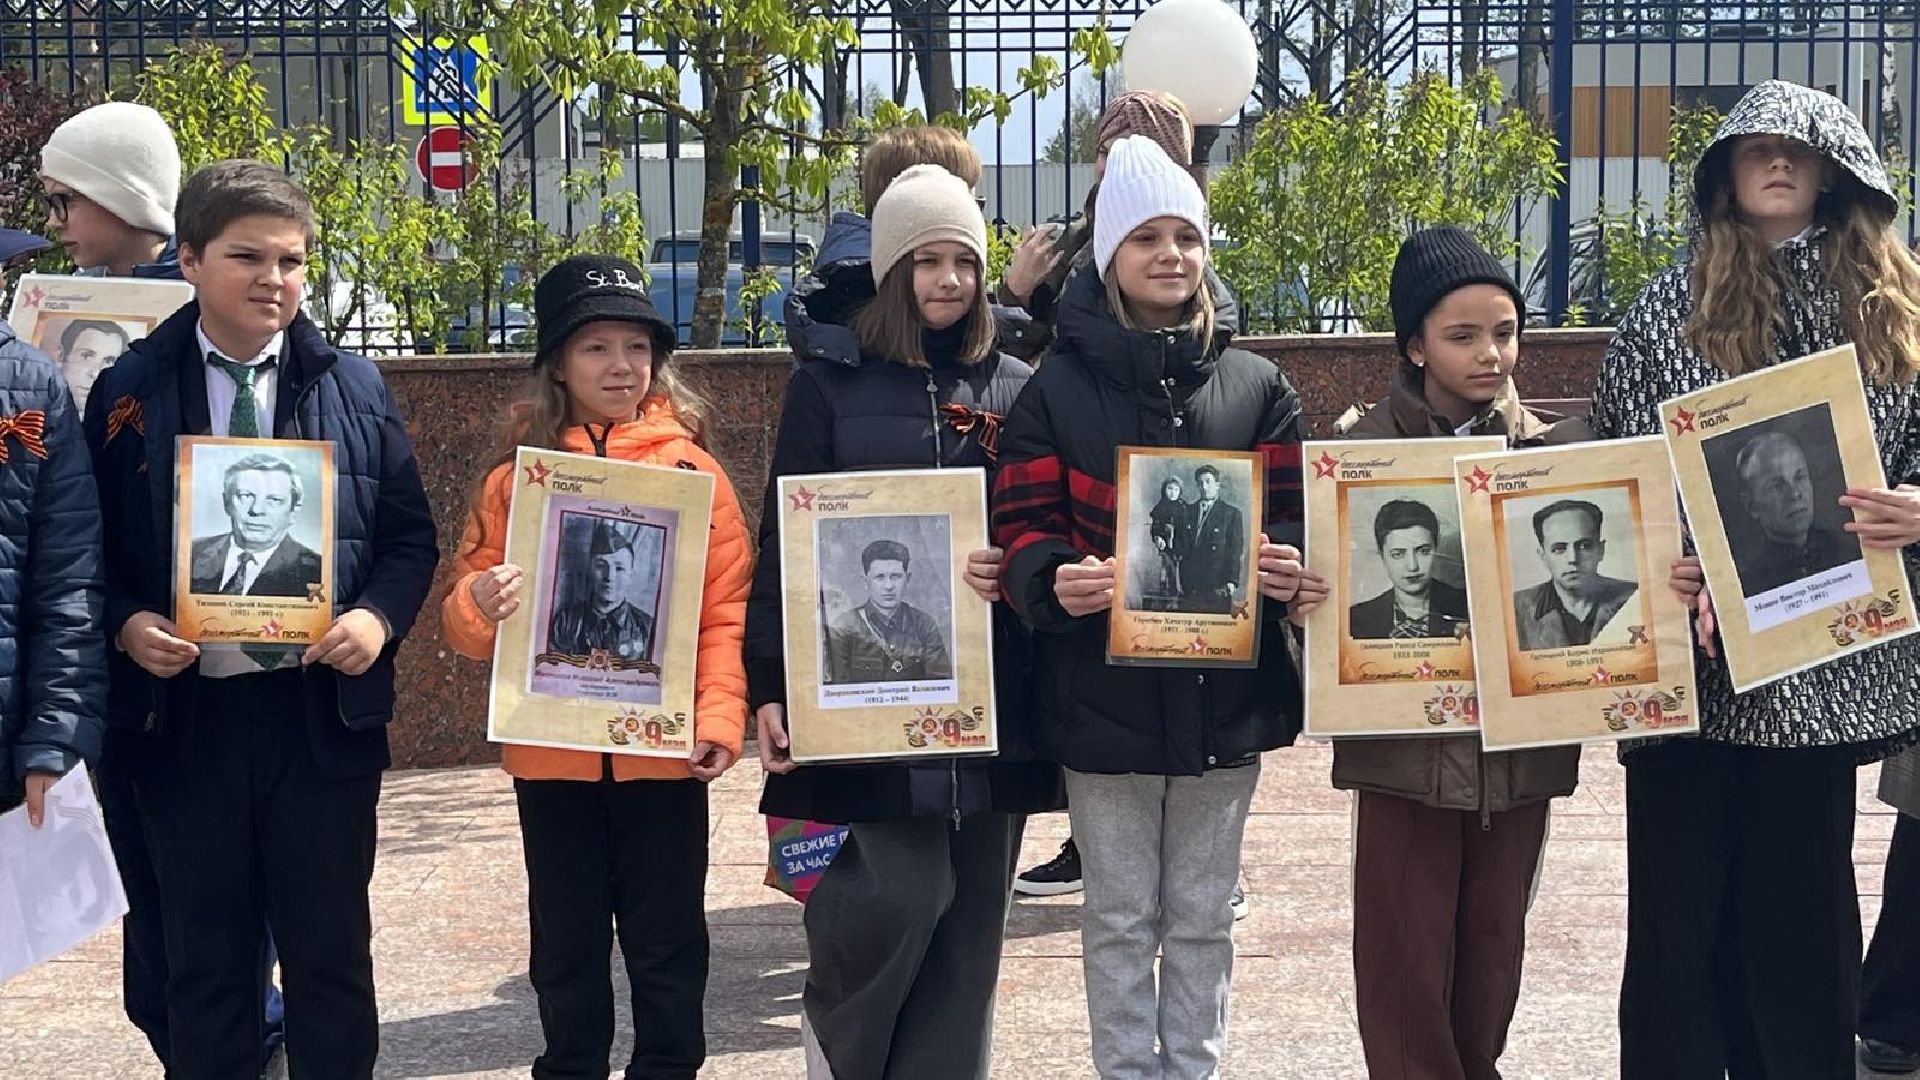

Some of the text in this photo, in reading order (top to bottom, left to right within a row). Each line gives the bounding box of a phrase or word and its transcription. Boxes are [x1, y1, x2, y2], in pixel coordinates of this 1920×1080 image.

[1700, 414, 1730, 430] ПОЛК
[1341, 469, 1373, 479] ПОЛК
[552, 481, 583, 494] ПОЛК
[1496, 480, 1528, 492] ПОЛК
[818, 501, 849, 512] ПОЛК
[1863, 607, 1884, 638] 9
[282, 630, 311, 639] ПОЛК
[1206, 647, 1233, 656] ПОЛК
[1434, 668, 1461, 678] ПОЛК
[1610, 672, 1639, 684] ПОЛК
[1643, 699, 1663, 729] 9
[644, 720, 663, 748] 9
[943, 717, 962, 748] 9
[781, 834, 837, 857] СВЕЖИЕ
[787, 853, 831, 874] ЗА ЧАС
